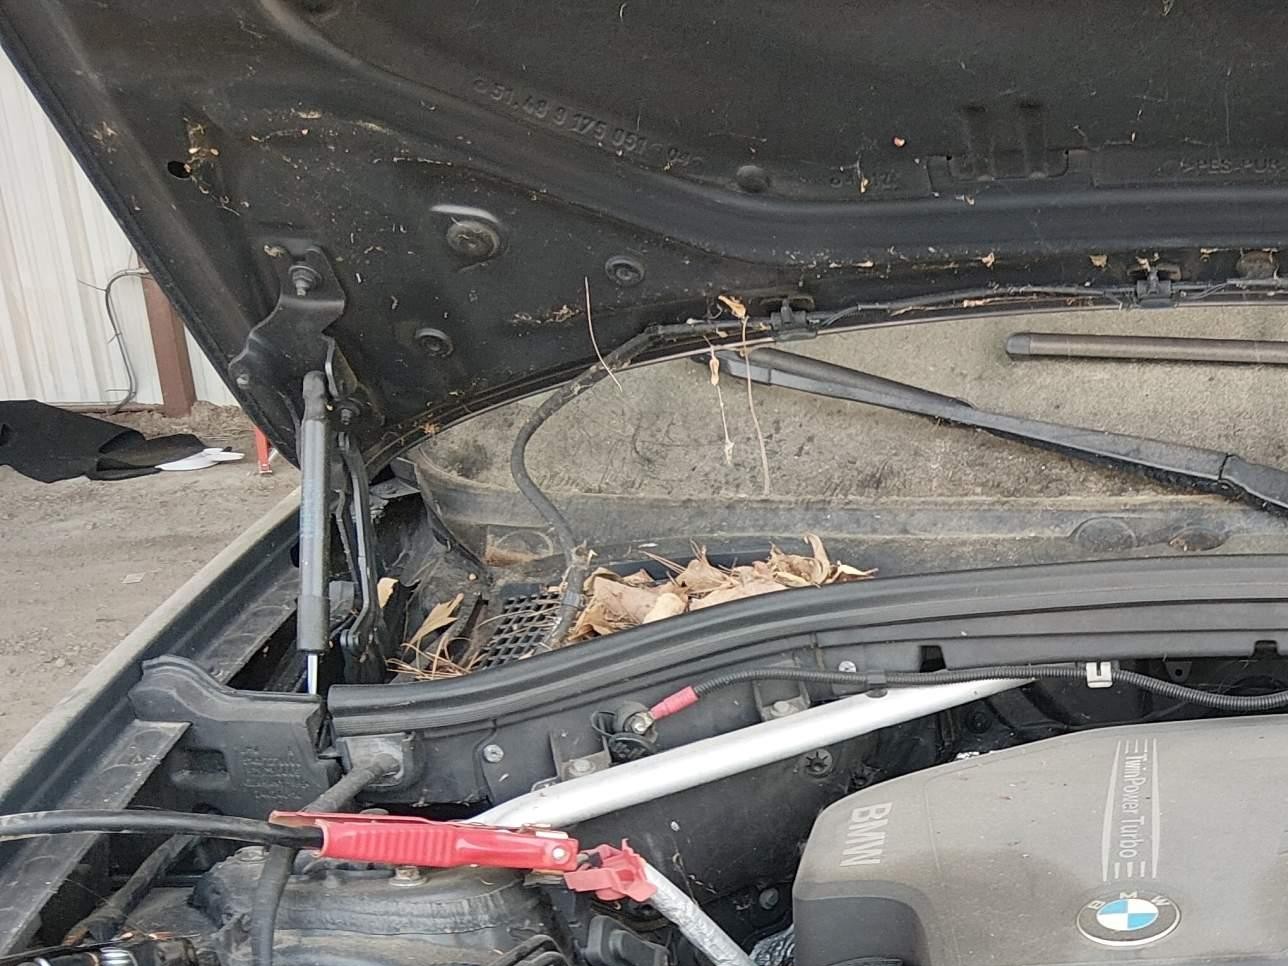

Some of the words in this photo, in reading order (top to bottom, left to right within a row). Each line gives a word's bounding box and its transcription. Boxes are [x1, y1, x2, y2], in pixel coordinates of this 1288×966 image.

[1121, 753, 1148, 815] TwinPower
[840, 802, 893, 867] BMW
[1119, 815, 1145, 858] Turbo
[1087, 890, 1171, 910] BMW
